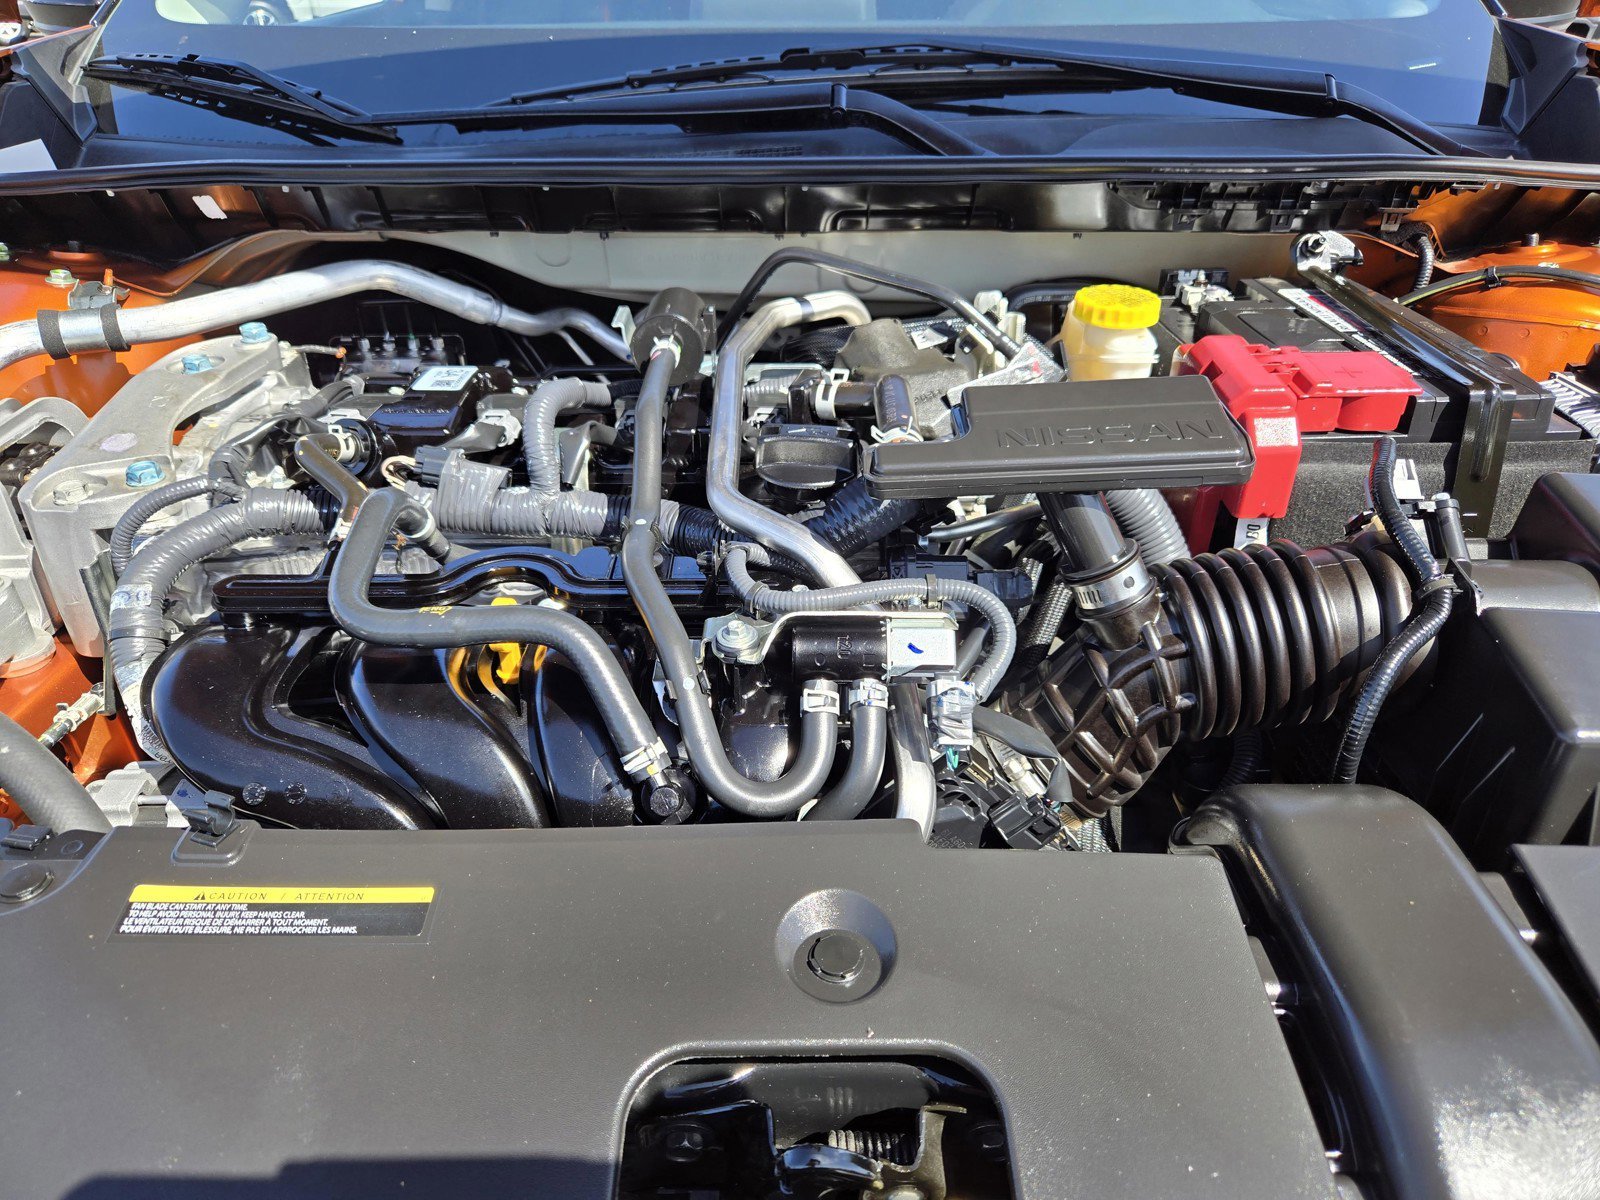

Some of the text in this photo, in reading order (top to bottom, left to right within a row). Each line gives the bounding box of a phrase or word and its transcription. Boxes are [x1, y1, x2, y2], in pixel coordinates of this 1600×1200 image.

[996, 419, 1223, 448] NISSAN
[209, 892, 267, 900] CAUTION
[294, 892, 364, 900] ATTENTION
[129, 910, 138, 918] TO
[138, 910, 158, 918] HELP
[157, 910, 179, 918] AVOID
[178, 910, 214, 918] PERSONAL
[240, 910, 258, 918] KEEP
[258, 910, 283, 918] HANDS
[120, 925, 144, 933] POUR
[168, 925, 194, 933] TOUTE
[233, 925, 245, 933] NE
[245, 925, 260, 933] PAS
[260, 925, 271, 933] EN
[272, 925, 318, 933] APPROCHER
[318, 925, 330, 933] LES
